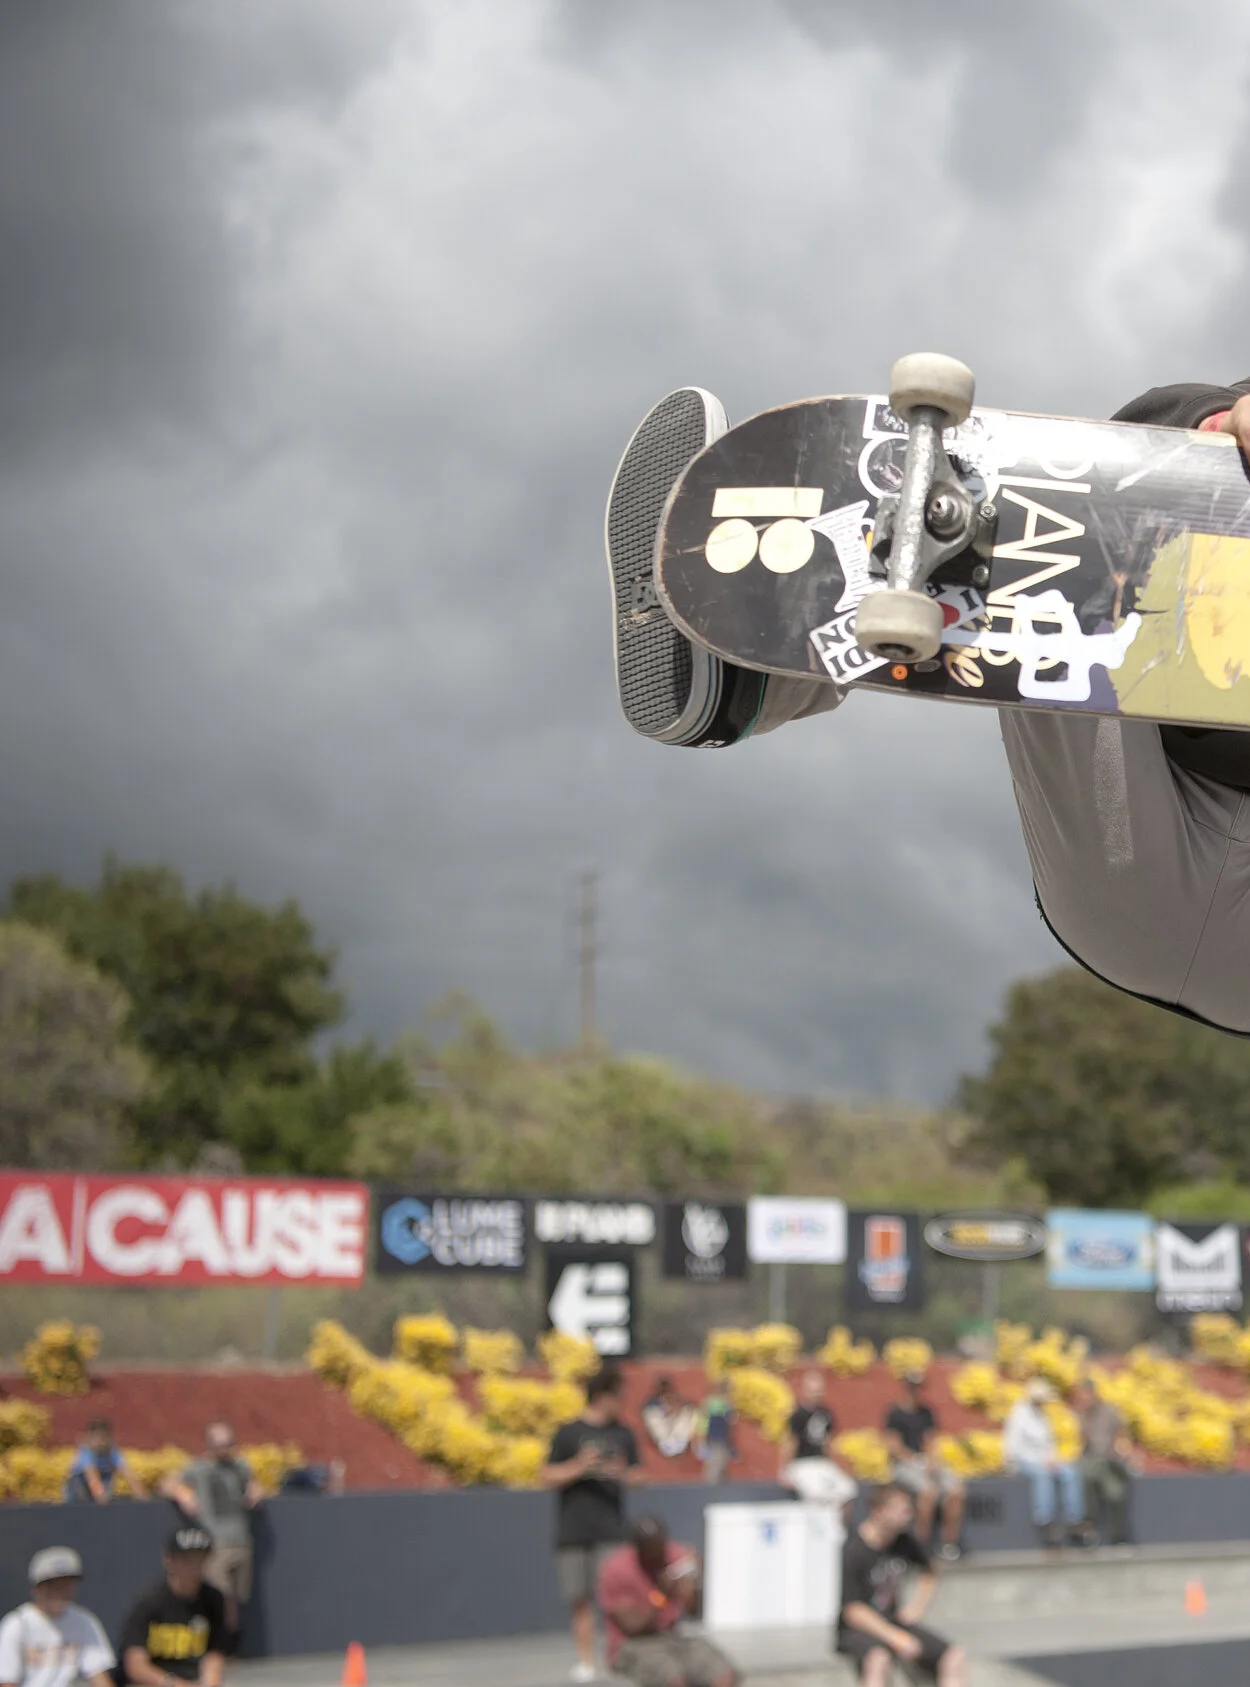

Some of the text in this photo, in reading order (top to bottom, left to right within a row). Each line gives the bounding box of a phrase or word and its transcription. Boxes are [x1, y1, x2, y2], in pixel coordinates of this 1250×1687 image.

[86, 1186, 365, 1279] CAUSE
[433, 1200, 523, 1233] LUME
[434, 1234, 523, 1267] CUBE
